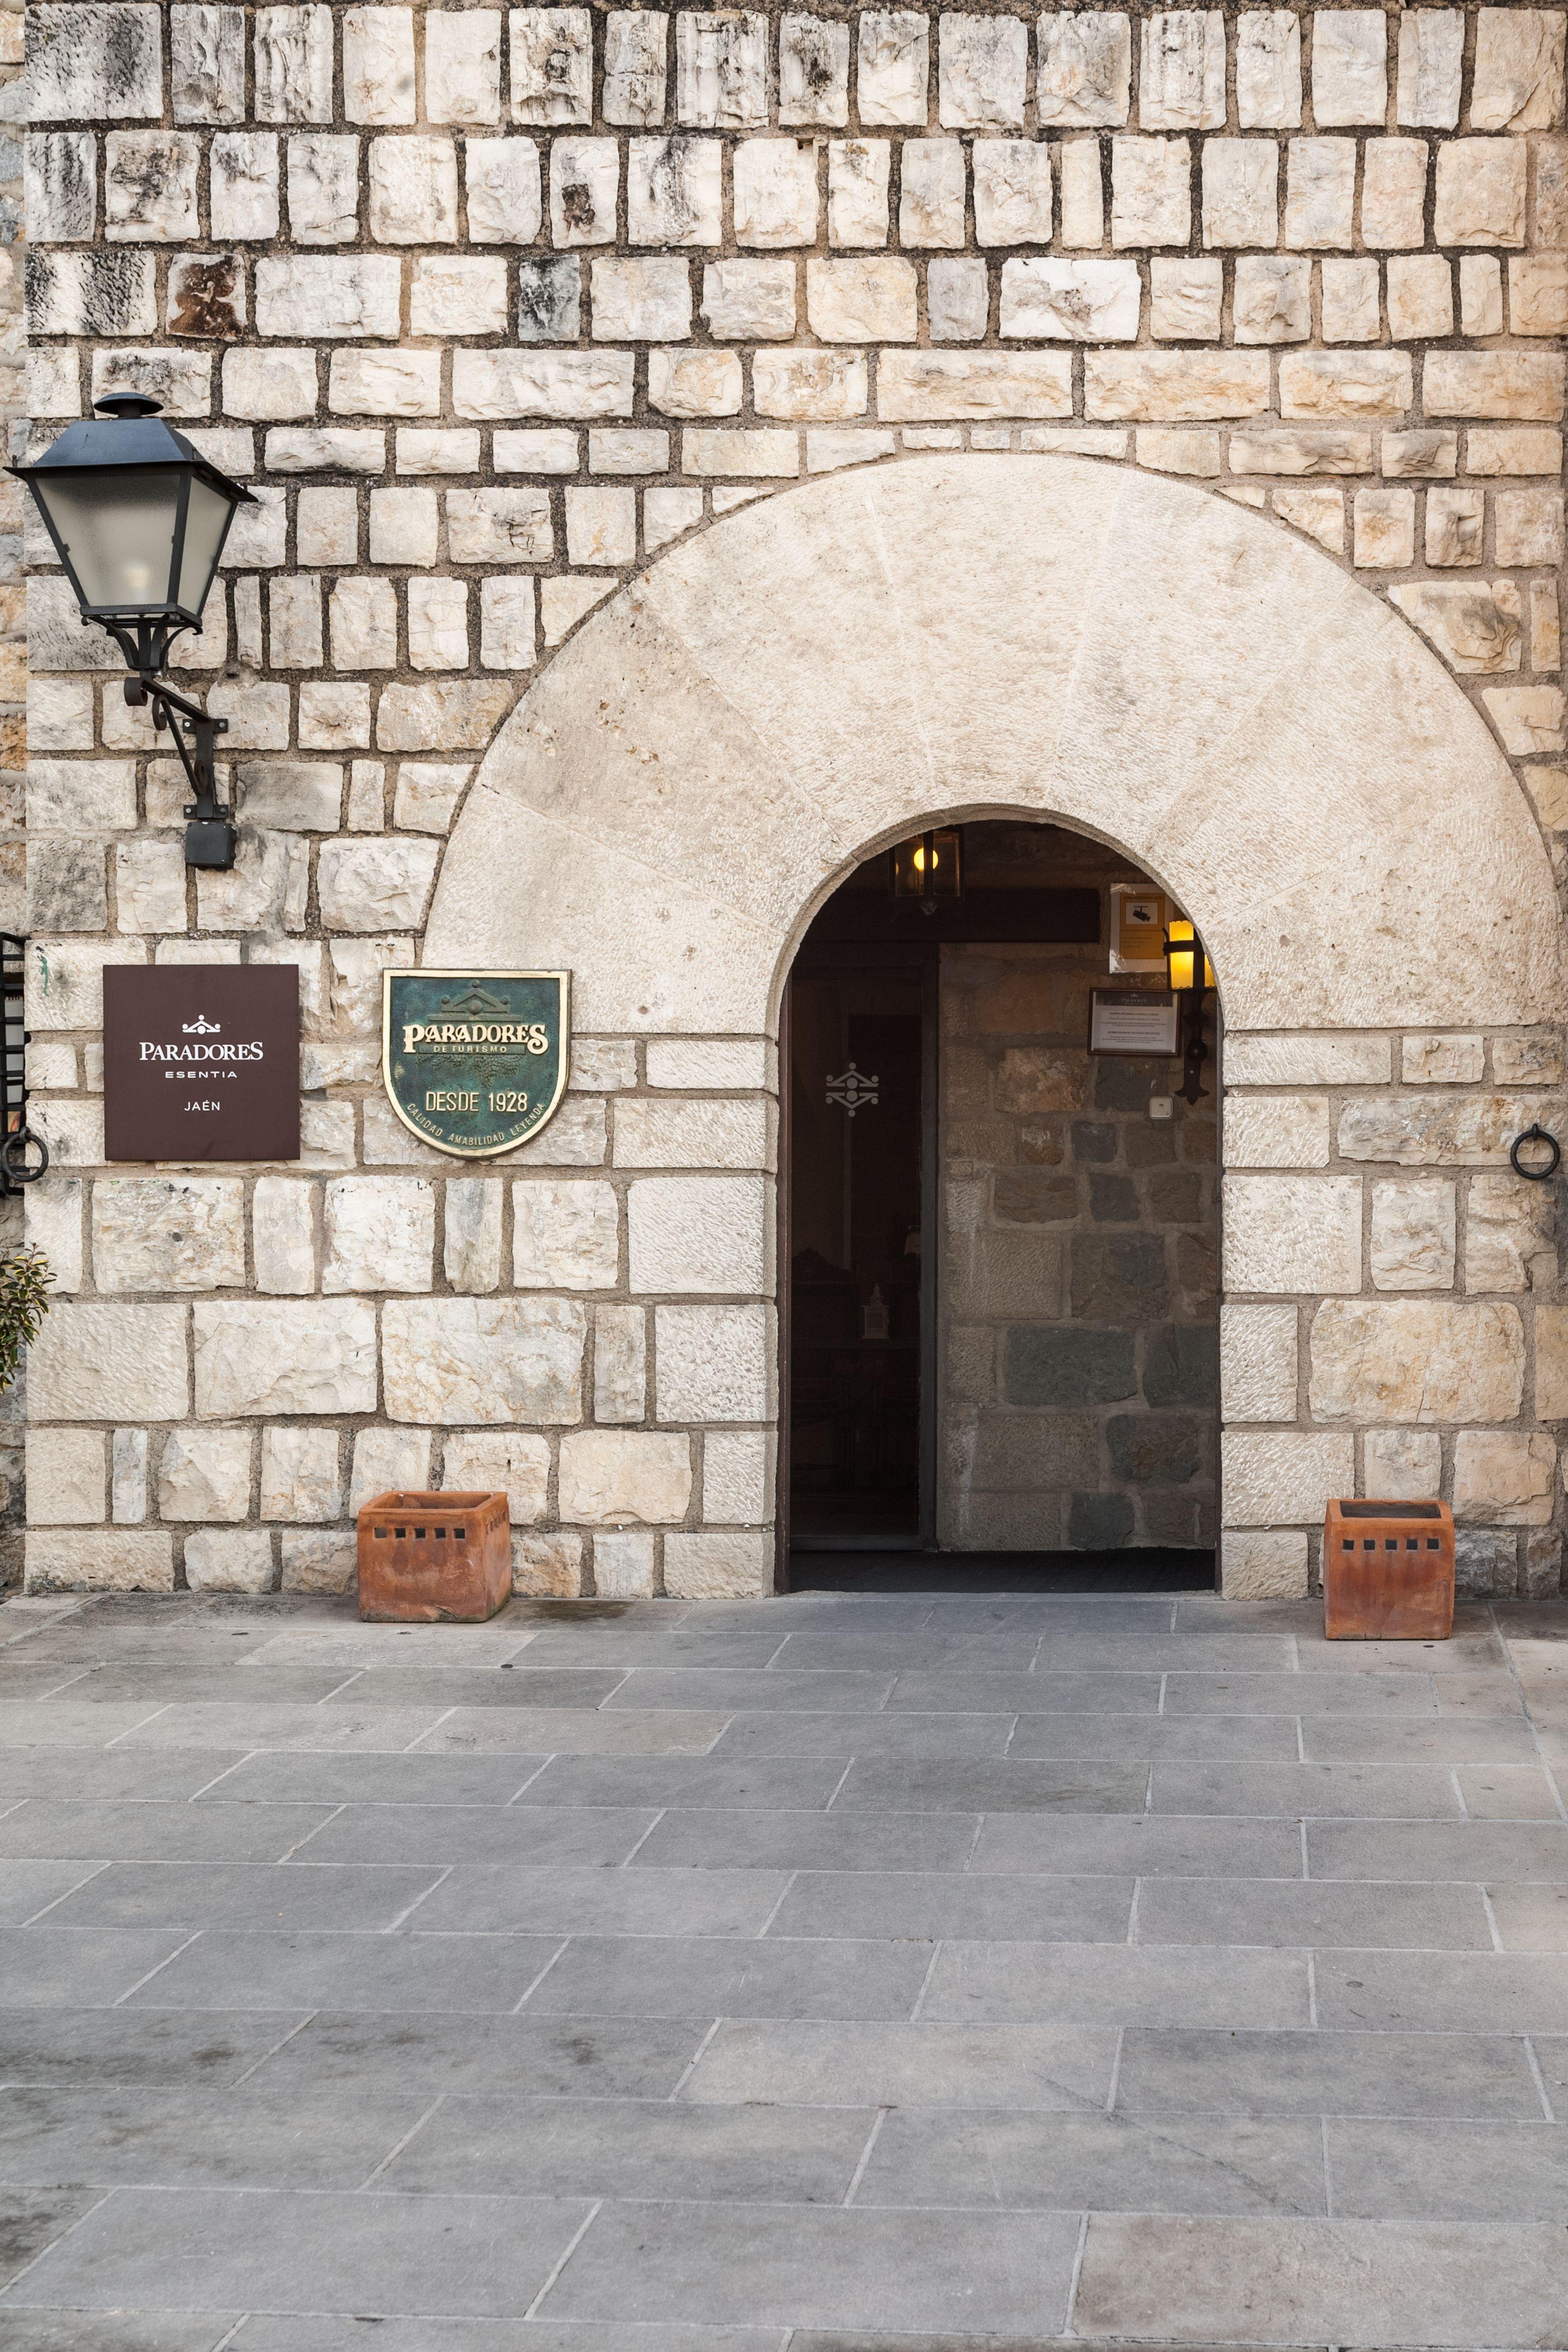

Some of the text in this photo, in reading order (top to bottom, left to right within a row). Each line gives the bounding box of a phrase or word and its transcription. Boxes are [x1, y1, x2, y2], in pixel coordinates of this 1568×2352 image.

[402, 1024, 549, 1055] PARADORES
[139, 1042, 263, 1060] PARADORES
[184, 1100, 220, 1111] JAÉN
[426, 1091, 528, 1112] DESDE 1928
[407, 1103, 545, 1146] CALIDAD AMABILIDAD LEYENDA
